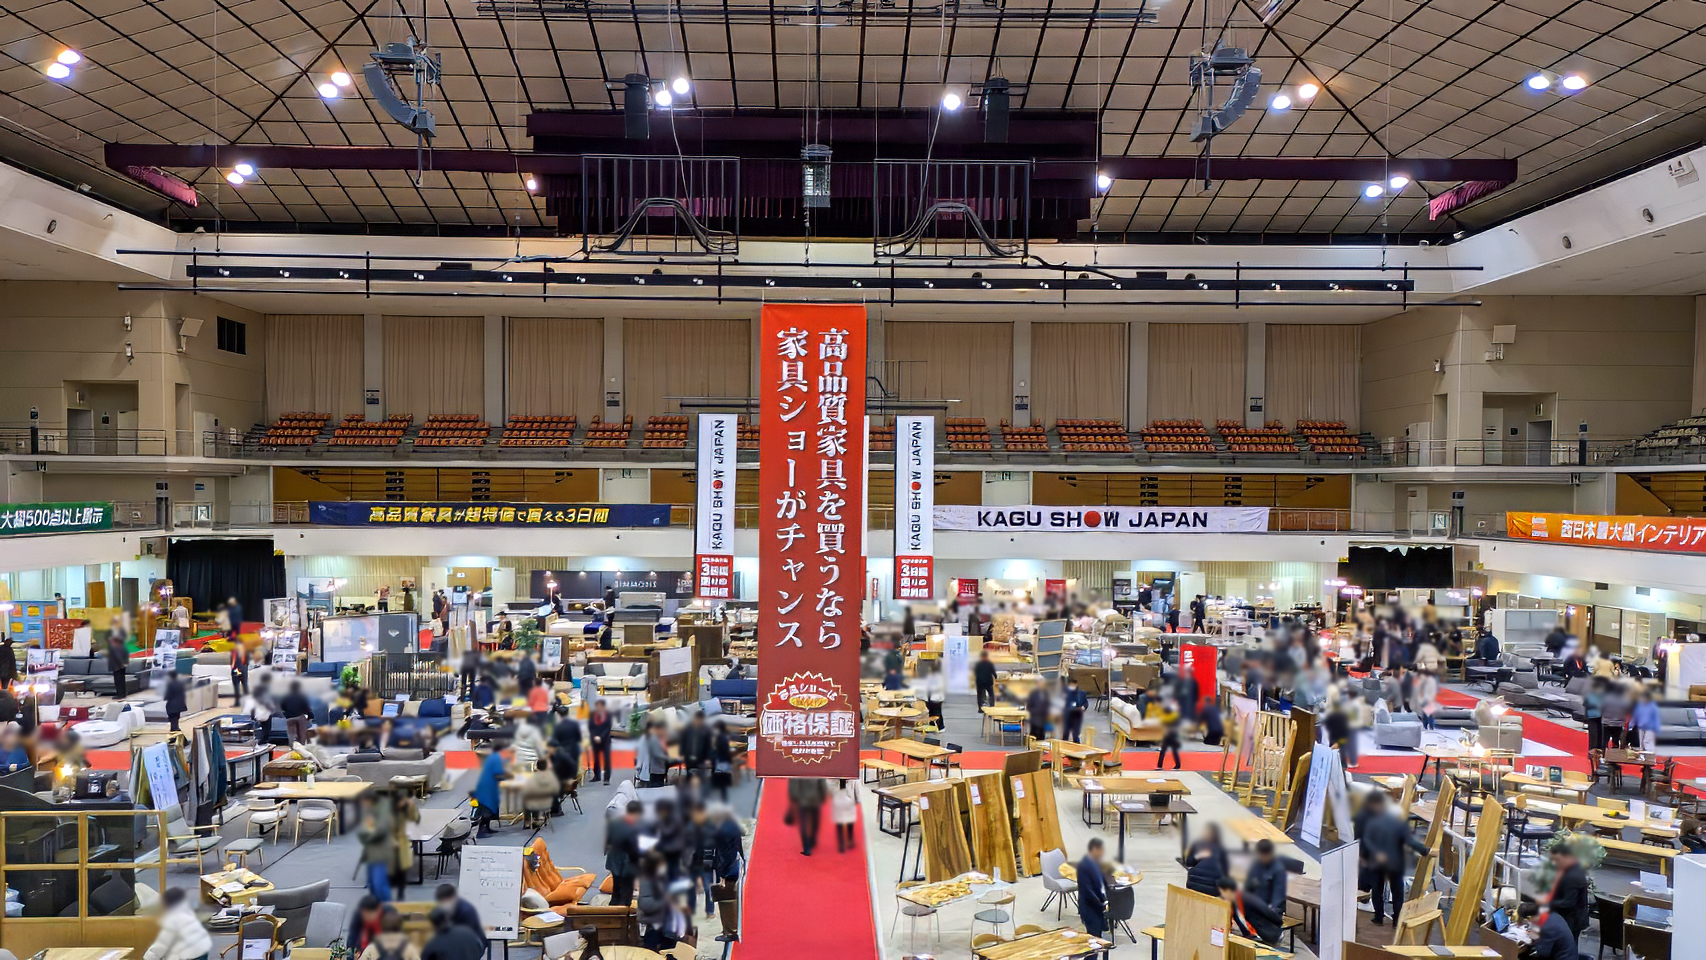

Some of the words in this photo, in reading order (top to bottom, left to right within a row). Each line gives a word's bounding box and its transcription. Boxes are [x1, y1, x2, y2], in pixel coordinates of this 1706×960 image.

[714, 419, 725, 464] JAPAN
[911, 421, 922, 465] JAPAN
[775, 326, 808, 648] 家具ショーがチャンス
[815, 327, 849, 649] 高品質家具を買うなら
[911, 470, 921, 509] SHOW
[712, 513, 722, 550] KAGU
[910, 514, 921, 550] KAGU
[977, 511, 1042, 528] KAGU
[1050, 510, 1119, 528] SHOW
[1128, 511, 1208, 528] JAPAN
[762, 711, 853, 737] 価格保証
